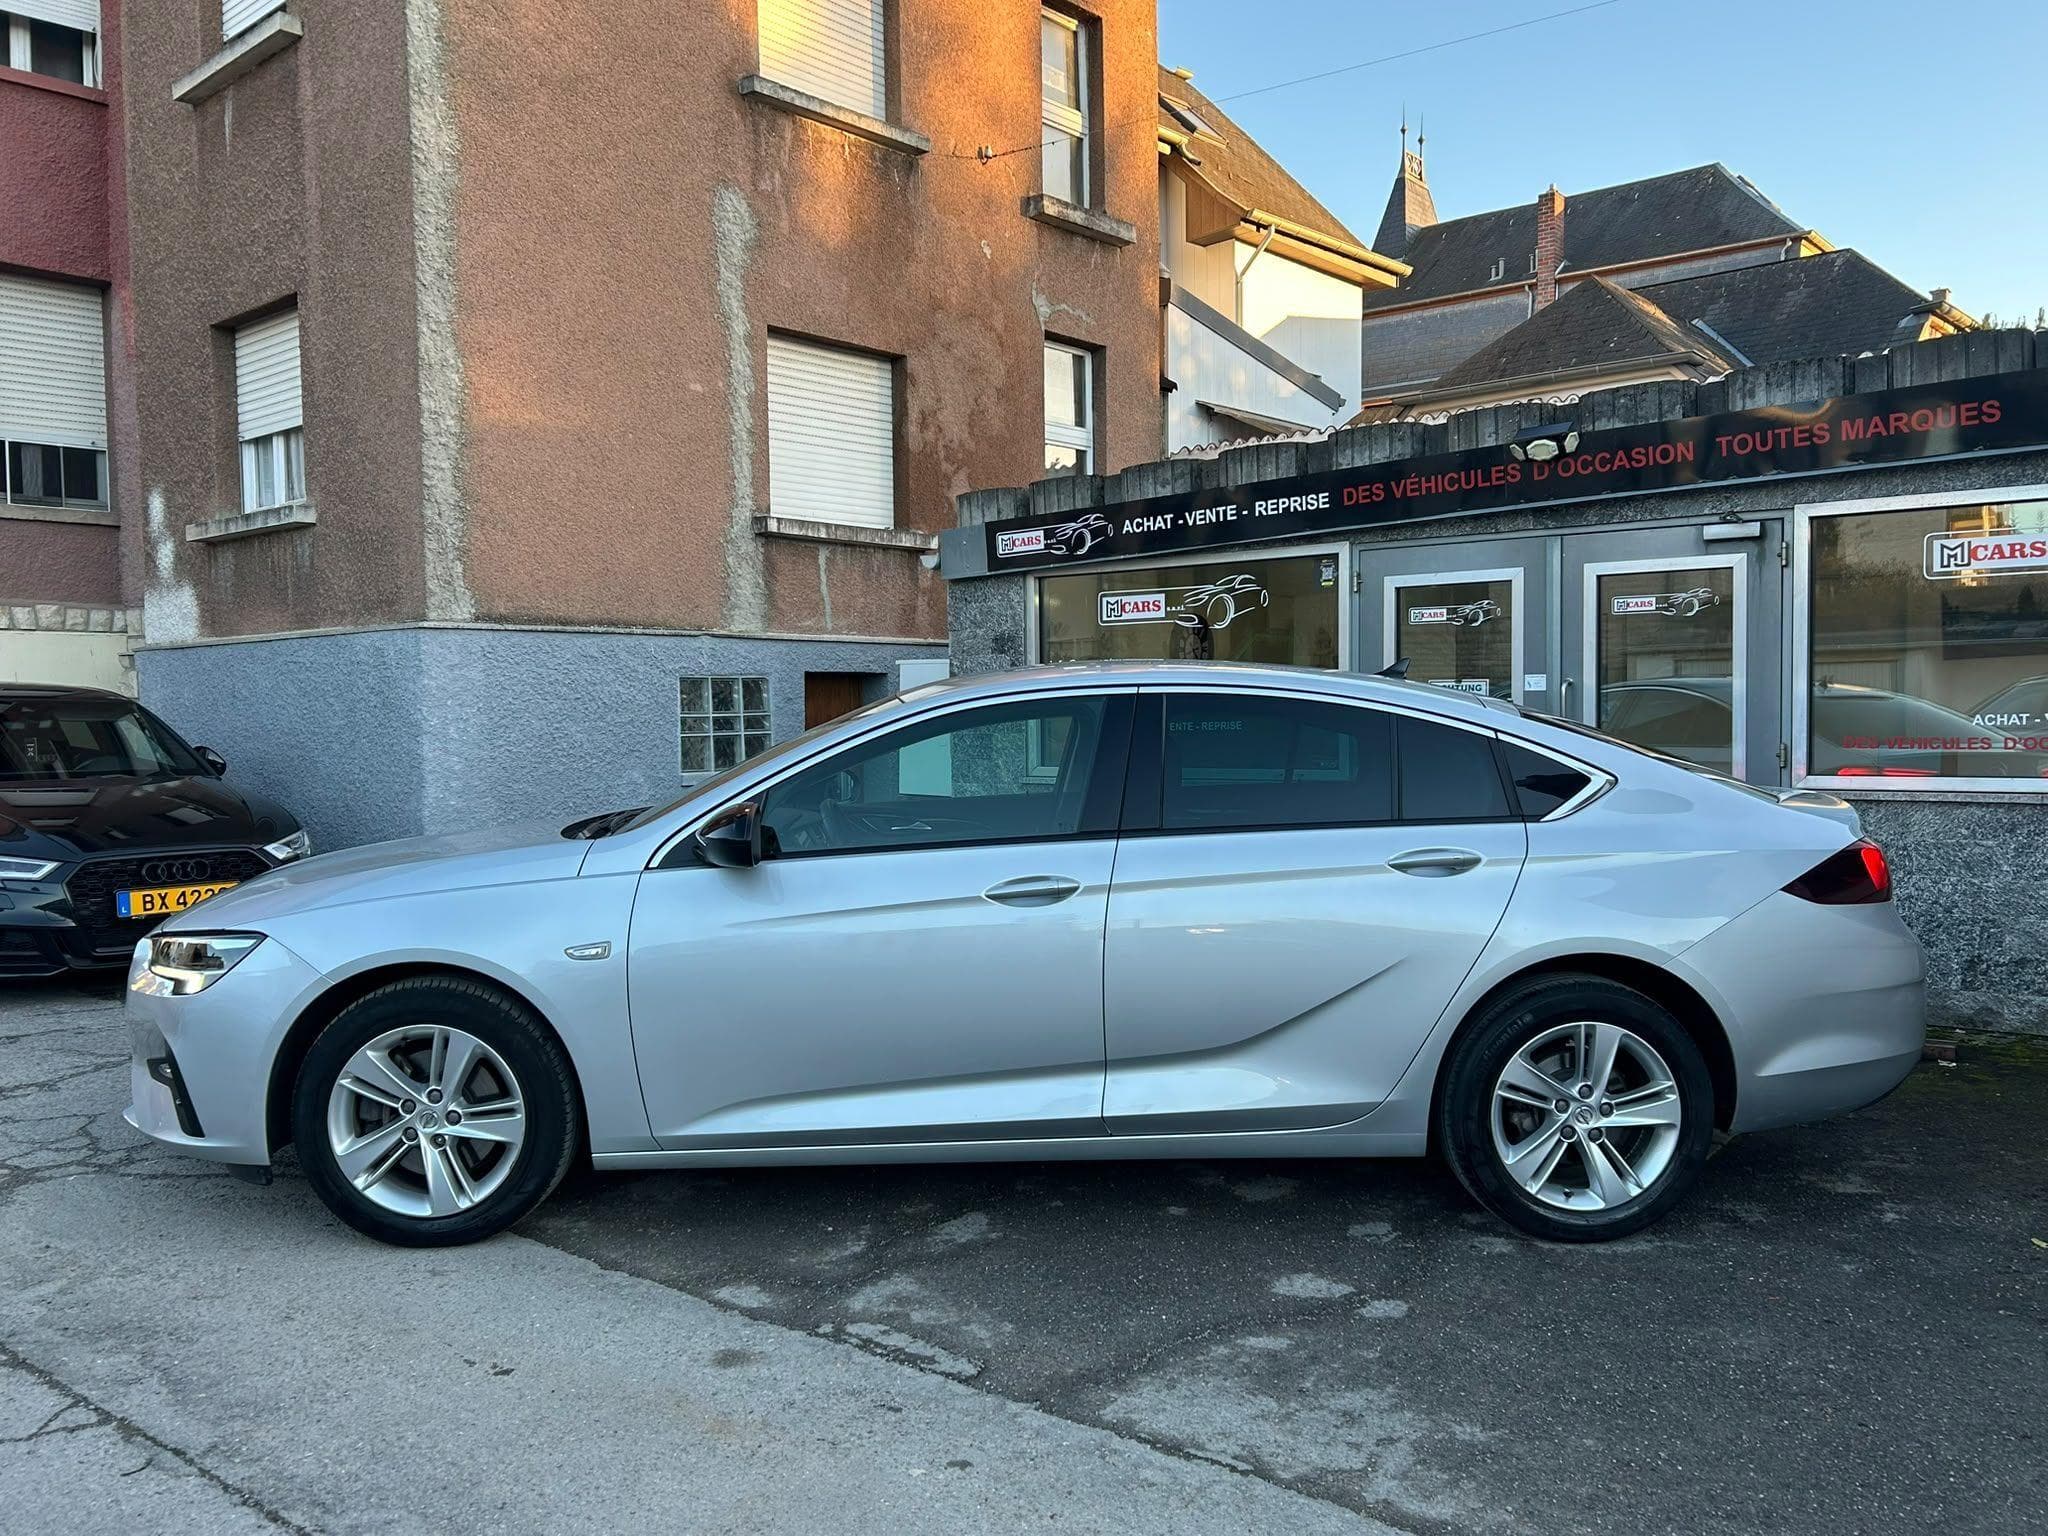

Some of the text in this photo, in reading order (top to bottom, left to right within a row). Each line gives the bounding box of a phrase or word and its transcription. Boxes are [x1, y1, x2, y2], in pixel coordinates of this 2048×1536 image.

[1122, 514, 1174, 534] ACHAT
[1255, 493, 1330, 516] REPRISE
[1343, 484, 1385, 506] DES
[1391, 462, 1521, 499] VÉHICULES
[1533, 441, 1695, 481] D'OCCASION
[1715, 423, 1831, 457] TOUTES
[1840, 399, 2002, 441] MARQUES
[1169, 721, 1195, 731] ENTE
[1201, 720, 1243, 731] REPRISE
[1972, 713, 2030, 726] ACHAT
[1842, 736, 1880, 749] DES
[142, 892, 169, 911] BX
